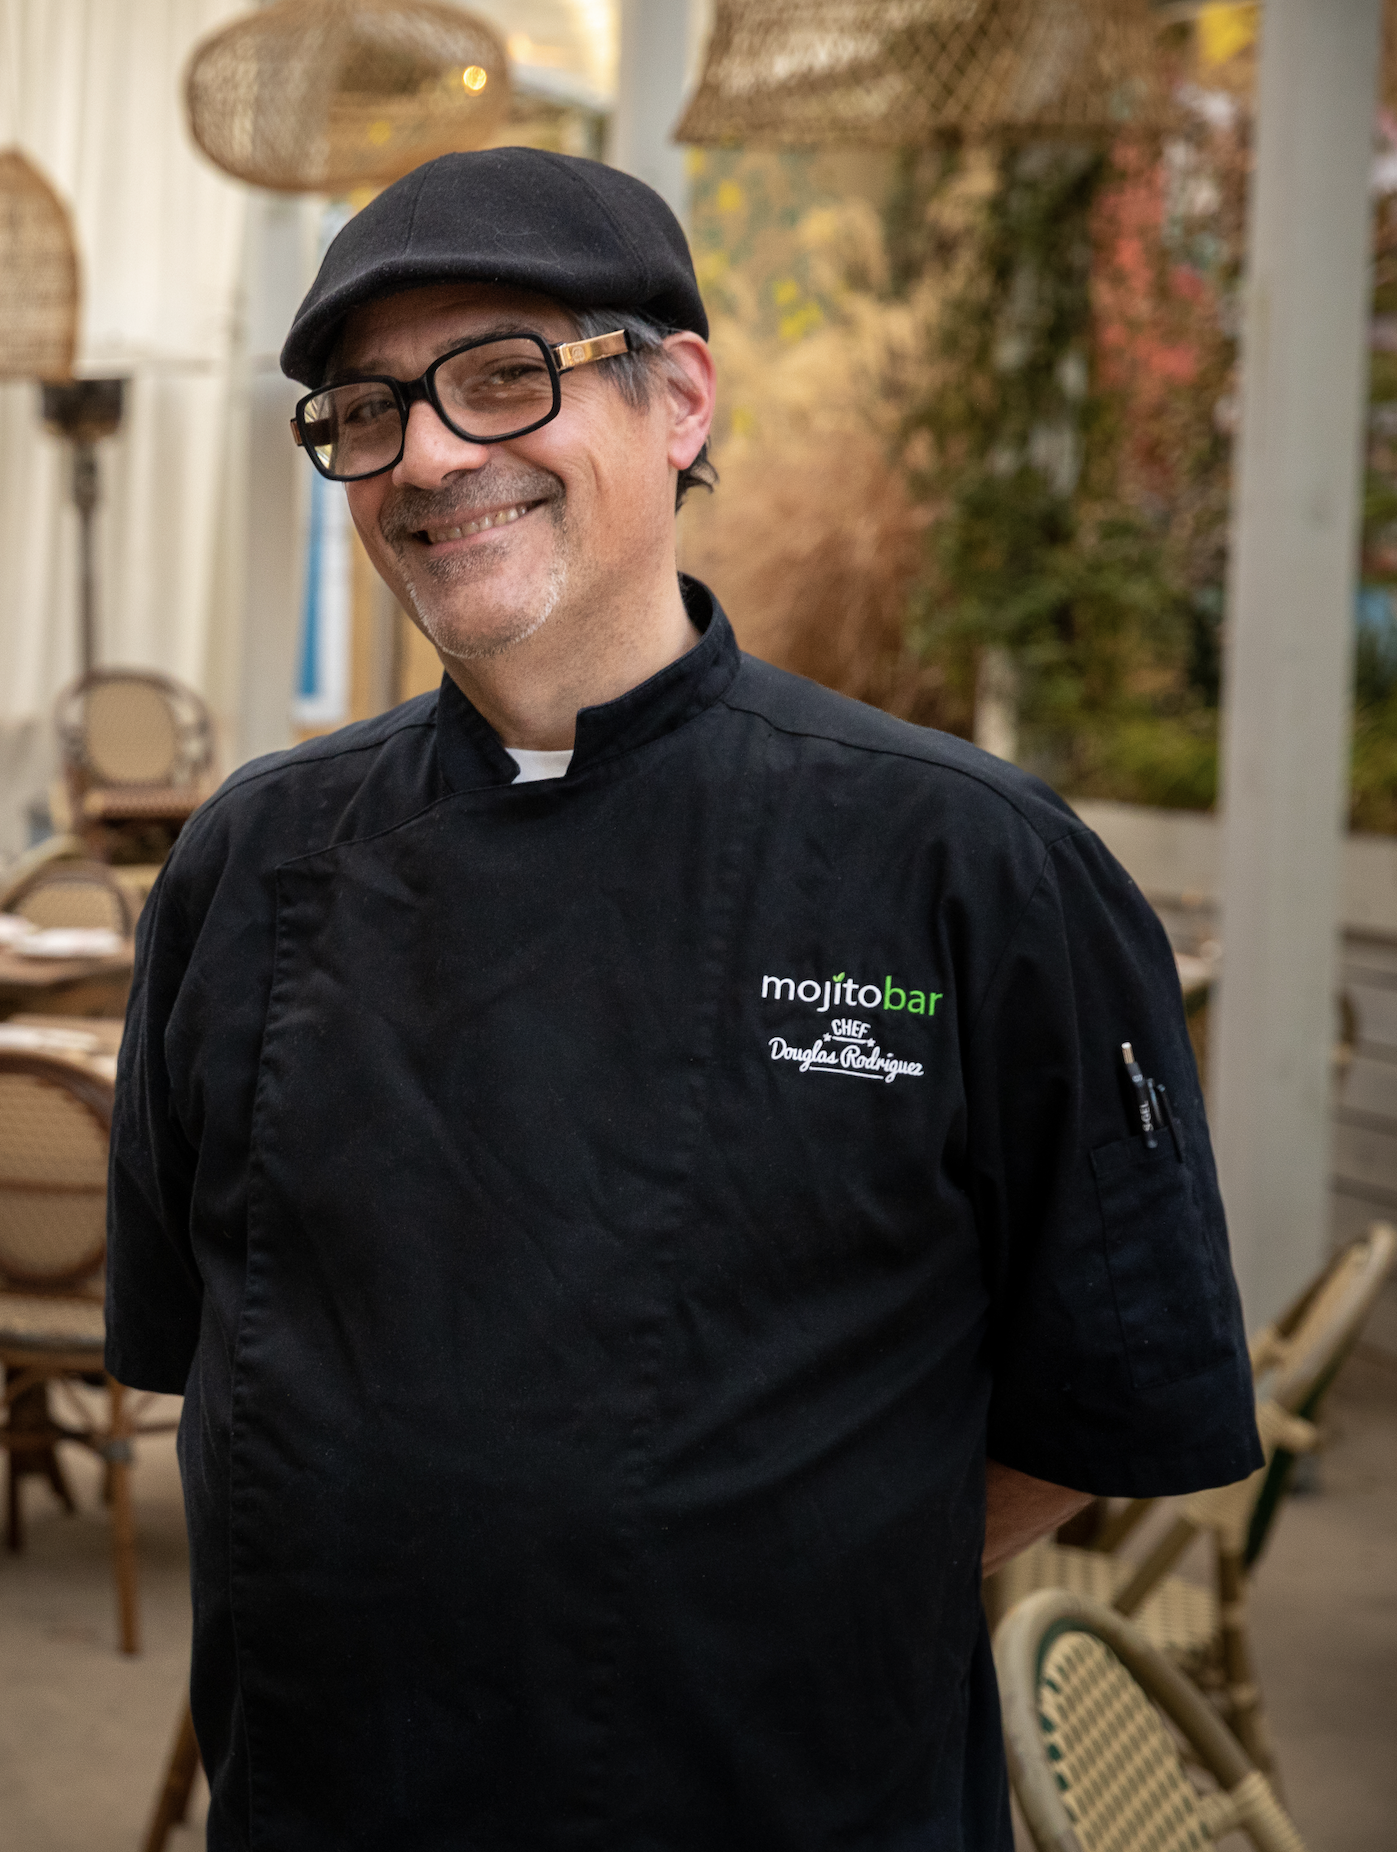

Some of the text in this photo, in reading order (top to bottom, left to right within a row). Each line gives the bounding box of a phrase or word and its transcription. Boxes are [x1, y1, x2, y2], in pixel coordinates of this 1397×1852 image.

[761, 972, 944, 1016] mojitobar
[831, 1018, 872, 1038] CHEF
[768, 1037, 924, 1083] Douglas Rodriguez
